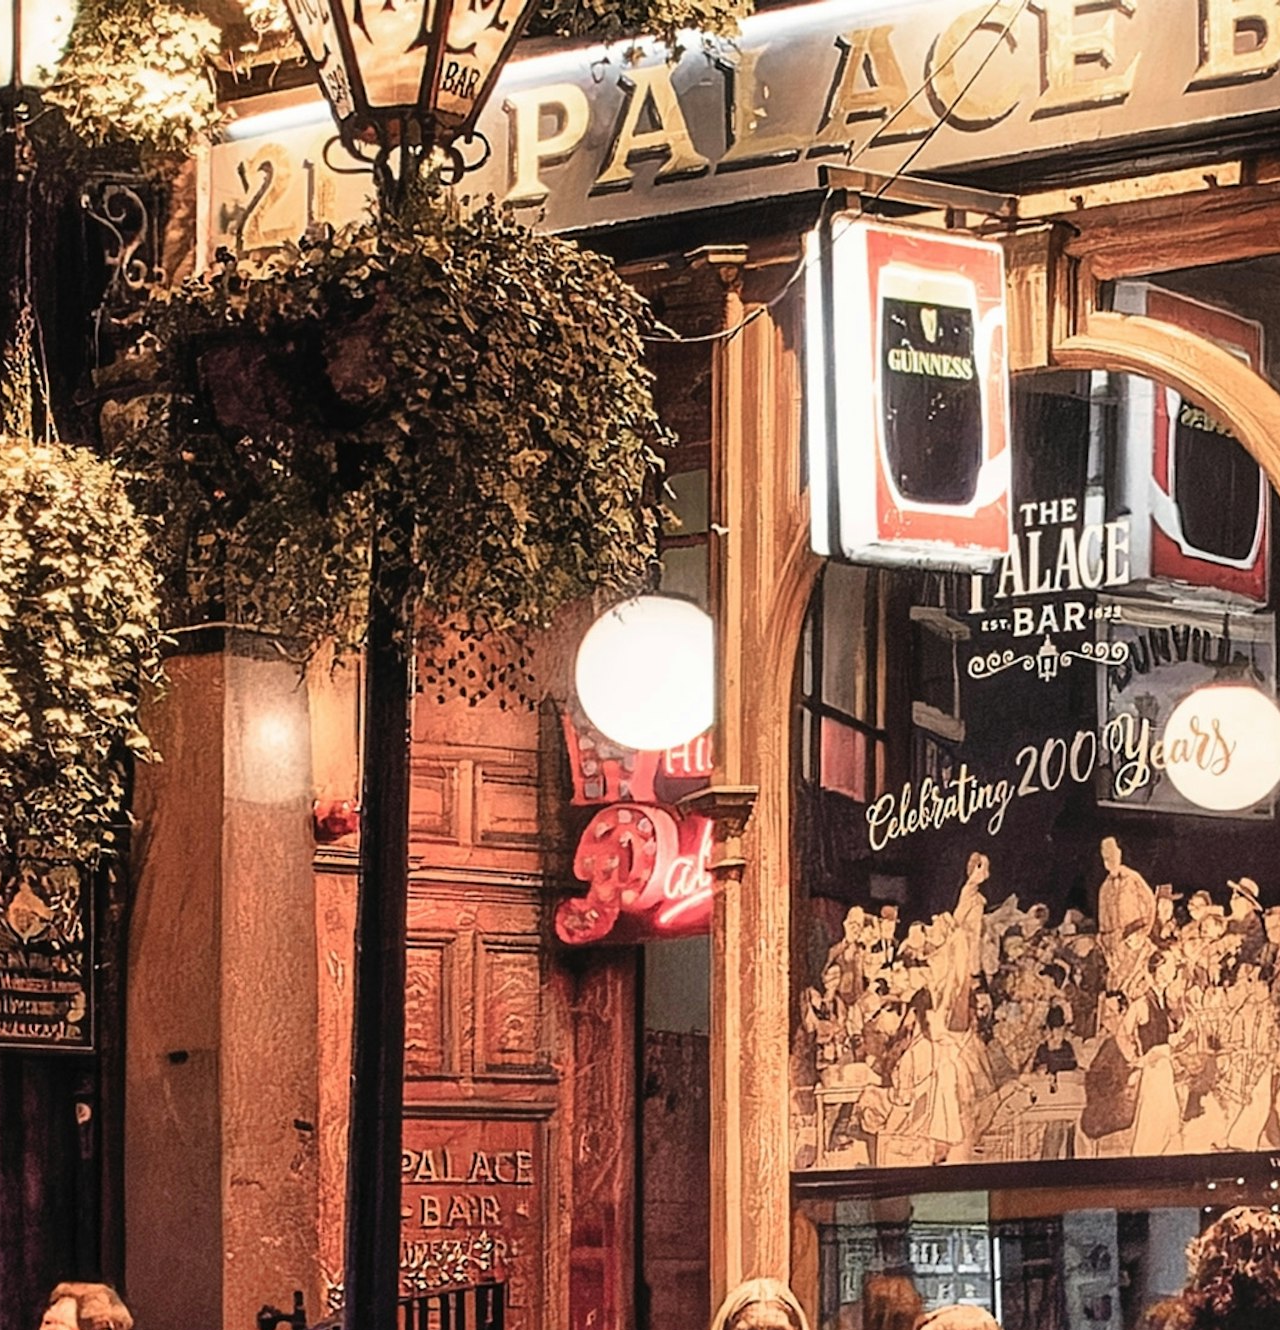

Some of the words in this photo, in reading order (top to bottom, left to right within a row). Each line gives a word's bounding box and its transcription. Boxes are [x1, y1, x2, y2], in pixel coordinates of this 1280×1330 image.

[441, 61, 480, 101] BAR
[503, 0, 1136, 208] PALACE
[887, 348, 973, 380] GUINNESS
[1020, 497, 1078, 527] THE
[1013, 601, 1087, 637] BAR
[866, 763, 1014, 852] Celebrating
[1015, 729, 1098, 798] 200
[1103, 712, 1237, 798] Years
[402, 1148, 534, 1184] PALACE
[420, 1193, 503, 1229] BAR
